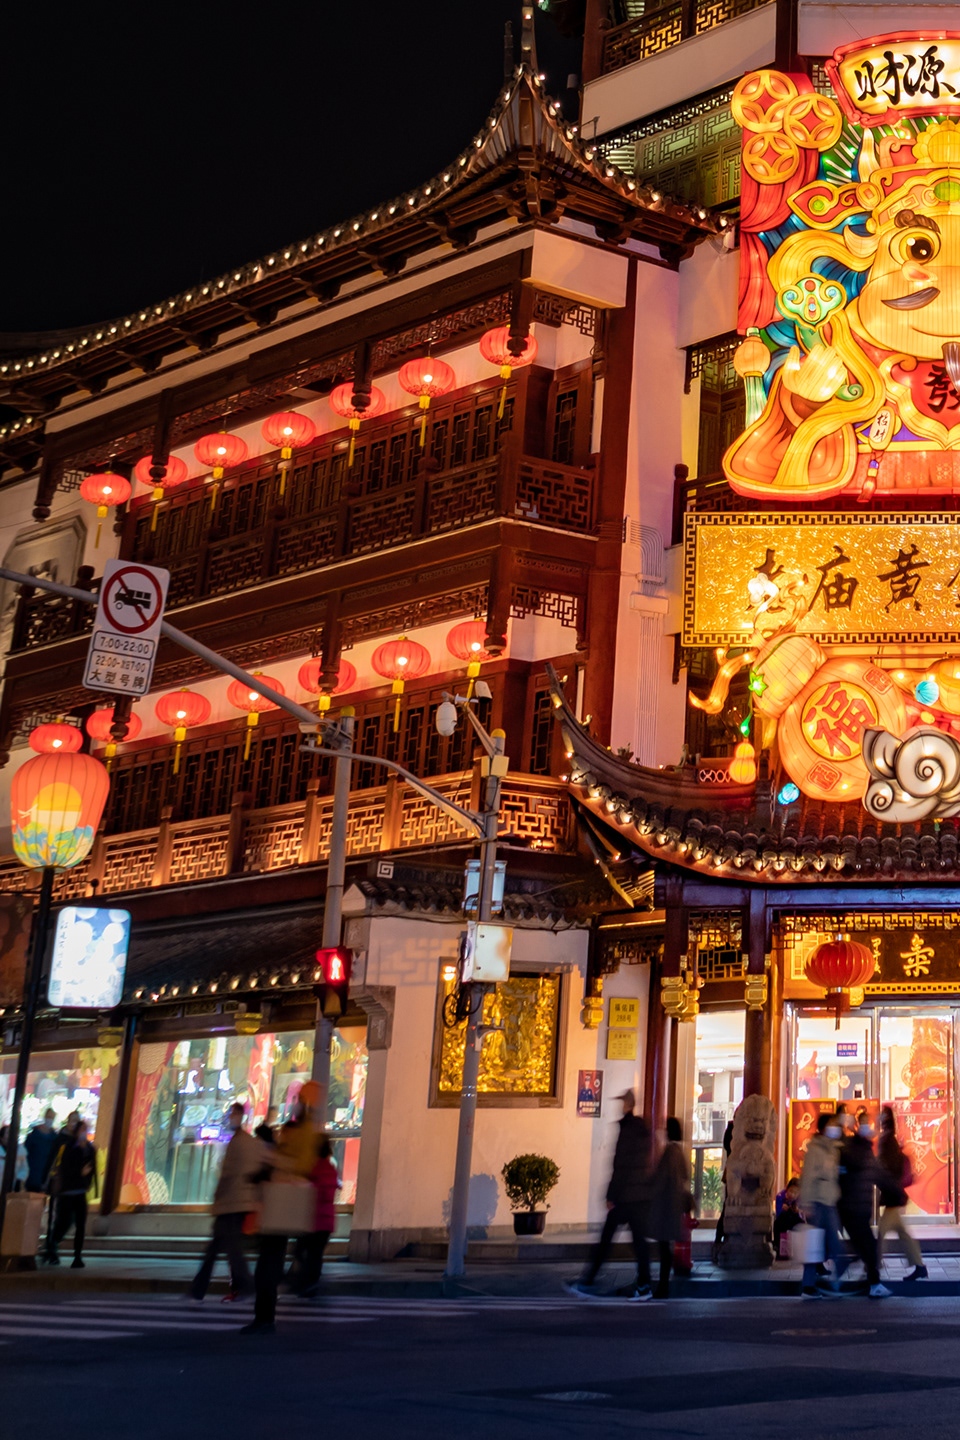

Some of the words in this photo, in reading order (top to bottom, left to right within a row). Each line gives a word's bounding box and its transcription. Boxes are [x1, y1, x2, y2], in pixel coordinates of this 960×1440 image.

[99, 636, 150, 655] 7:00-22:00
[88, 668, 146, 689] 大型号牌
